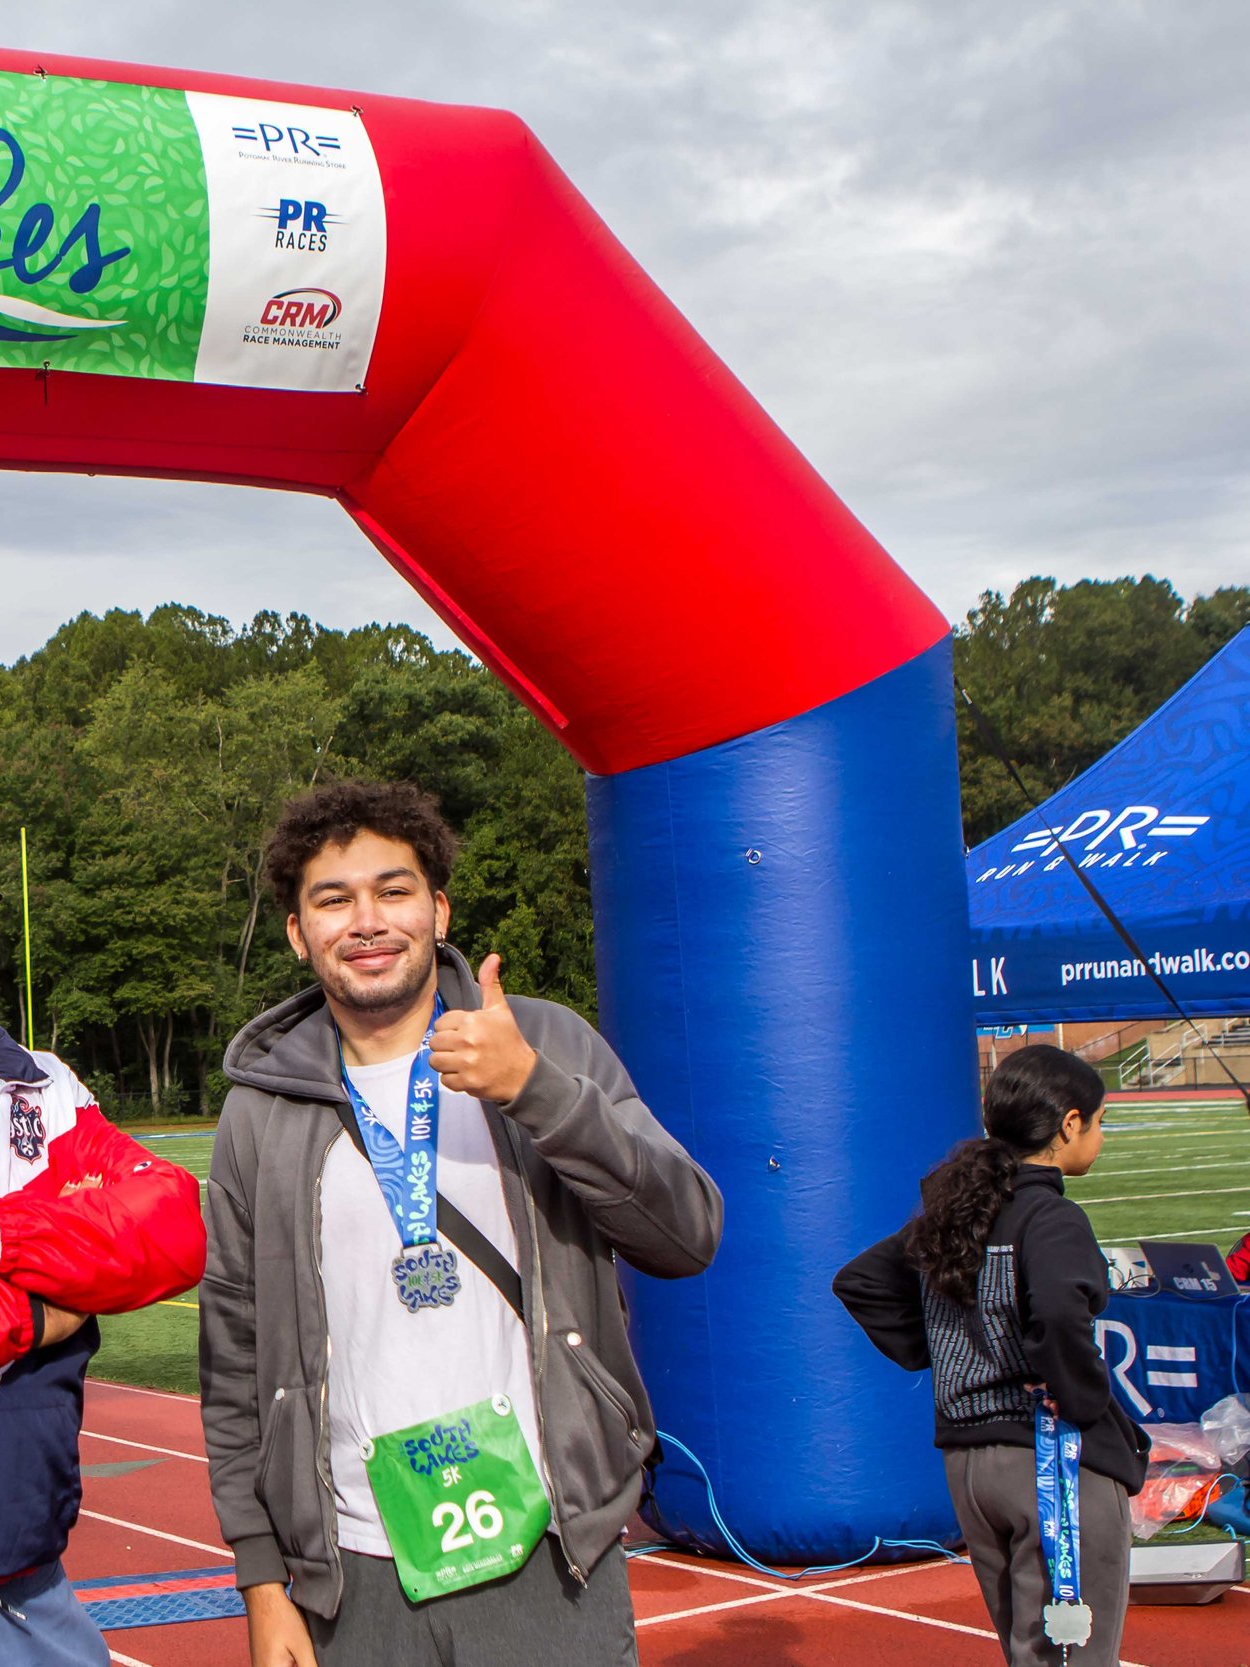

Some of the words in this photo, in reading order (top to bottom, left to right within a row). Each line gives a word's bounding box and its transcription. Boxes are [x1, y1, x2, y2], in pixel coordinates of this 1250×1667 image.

[277, 198, 327, 233] PR
[275, 231, 328, 252] RACES
[260, 299, 330, 329] CRM
[243, 334, 270, 345] RACE
[272, 335, 341, 350] MANAGEMENT
[244, 325, 342, 341] COMMONWEALTH
[975, 860, 1035, 883] RUN
[1078, 850, 1169, 869] WALK
[413, 1077, 433, 1099] 5K
[410, 1114, 432, 1141] 10K
[406, 1150, 433, 1223] LAKES
[394, 1250, 455, 1280] SOUTH
[399, 1275, 459, 1309] LAKES
[1172, 1276, 1203, 1291] CRM
[1200, 1278, 1218, 1292] 15
[404, 1417, 471, 1456] SOUTH
[410, 1441, 479, 1476] LAKES
[441, 1465, 462, 1488] 5K
[431, 1489, 504, 1553] 26
